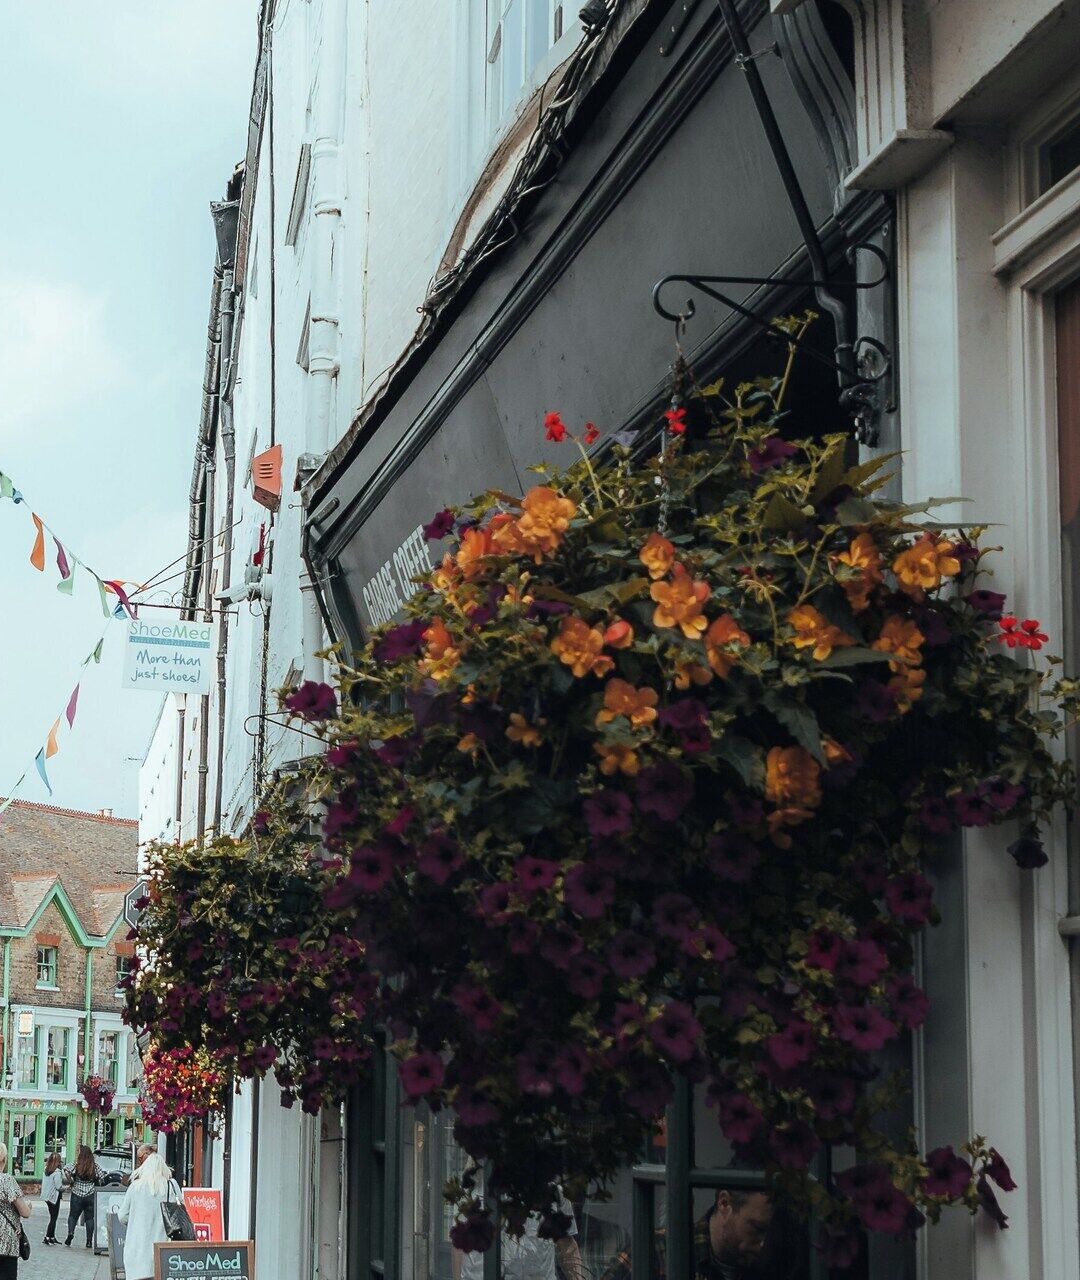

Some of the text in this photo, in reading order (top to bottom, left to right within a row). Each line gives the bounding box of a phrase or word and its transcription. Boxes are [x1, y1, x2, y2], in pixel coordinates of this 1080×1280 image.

[362, 560, 404, 627] GARAGE
[129, 621, 211, 641] ShoeMed
[136, 649, 201, 666] More than
[131, 667, 201, 684] just shoes!
